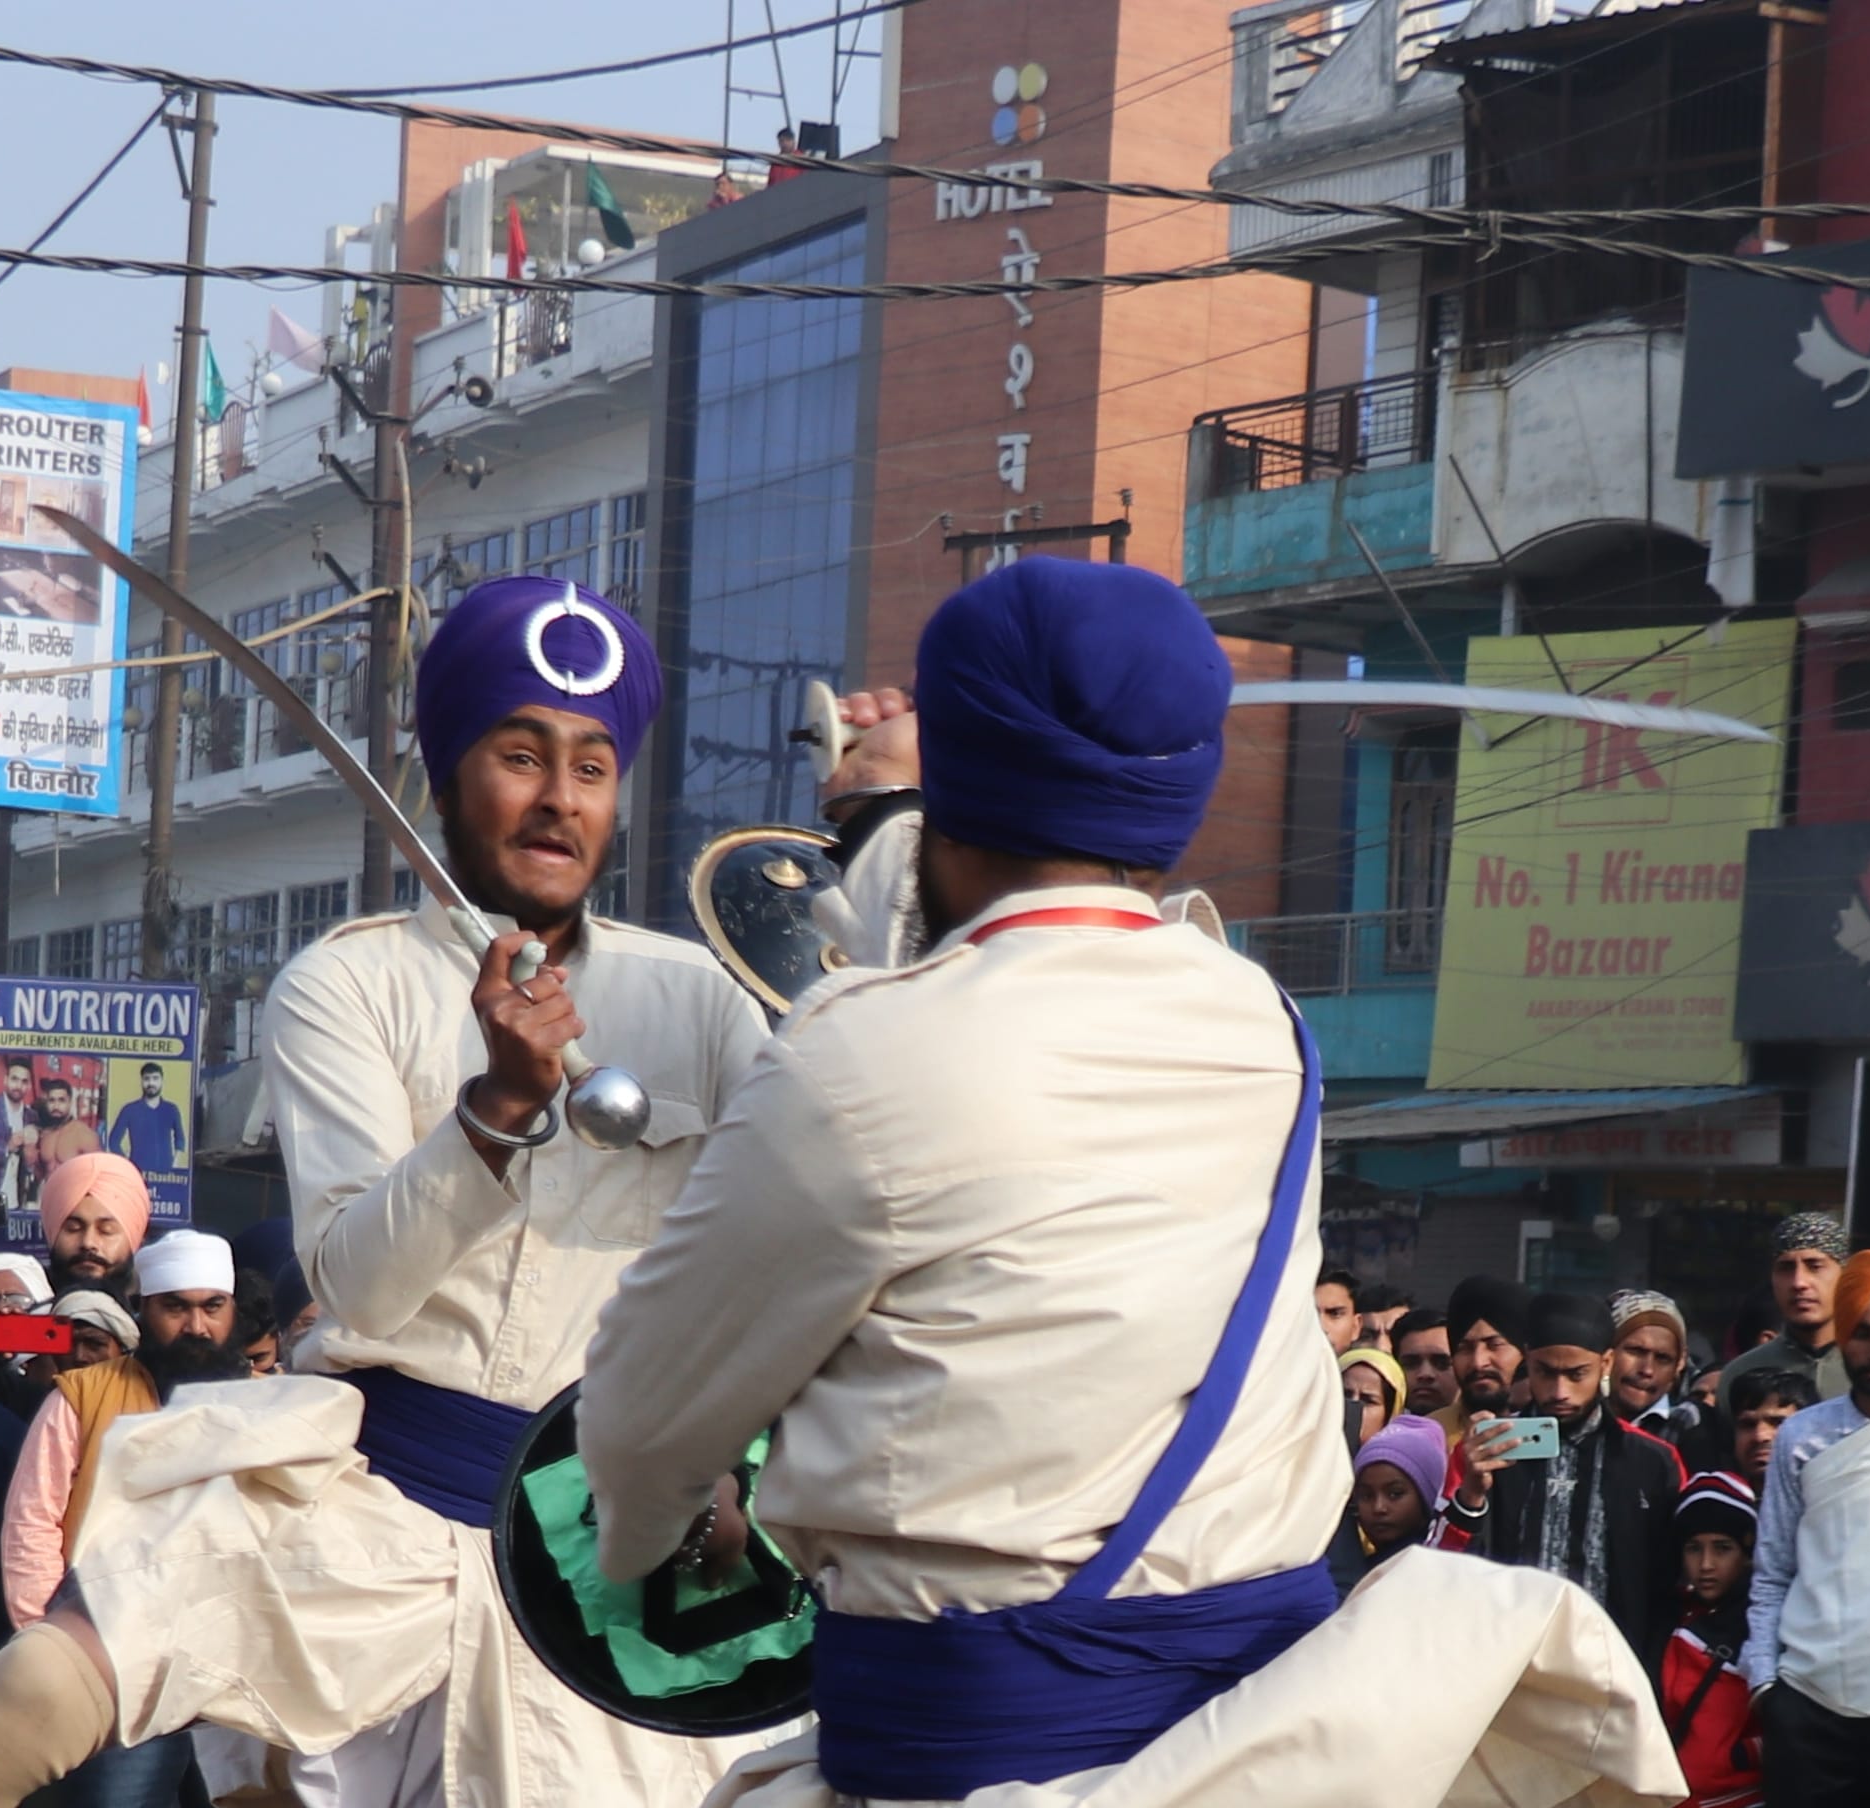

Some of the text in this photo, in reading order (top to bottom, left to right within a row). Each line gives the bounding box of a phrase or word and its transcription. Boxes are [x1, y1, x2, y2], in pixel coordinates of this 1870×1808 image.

[936, 159, 1053, 221] HOTEL
[2, 714, 17, 740] की
[51, 721, 63, 745] भी
[7, 759, 98, 798] बिजनौर
[1474, 850, 1744, 908] No. 1 Kirana
[1524, 925, 1672, 978] Bazaar
[14, 988, 190, 1036] NUTRITION
[79, 1036, 139, 1052] AVAILABLE
[142, 1039, 173, 1053] HERE
